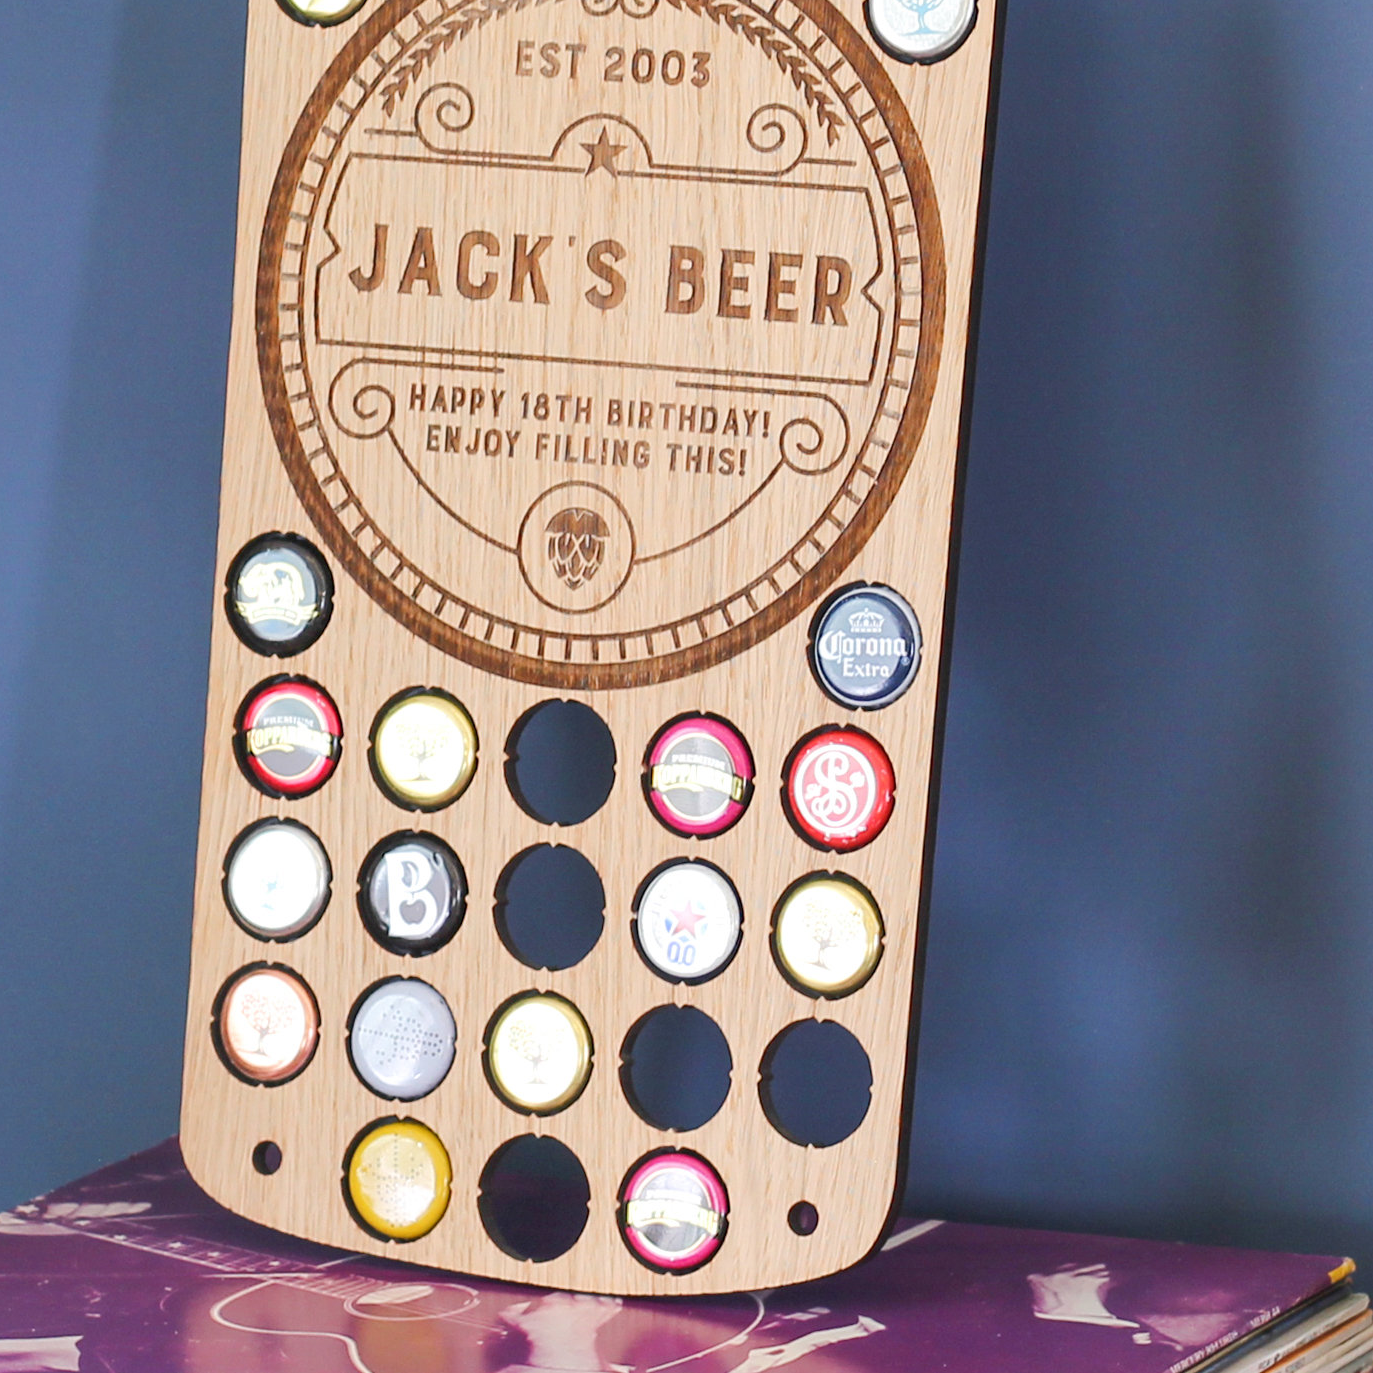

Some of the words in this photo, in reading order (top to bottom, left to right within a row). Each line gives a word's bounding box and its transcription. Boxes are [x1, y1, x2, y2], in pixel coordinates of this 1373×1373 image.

[516, 40, 587, 79] EST
[604, 46, 711, 88] 2003
[348, 223, 627, 310] JACK'S
[664, 245, 853, 326] BEER
[409, 383, 506, 418] HAPPY
[521, 391, 593, 424] 18TH
[608, 398, 771, 438] BIRTHDAY!
[426, 424, 521, 458] ENJOY
[535, 433, 651, 469] FILLING
[666, 442, 748, 476] THIS!
[818, 630, 908, 664] Corona
[842, 657, 890, 677] Extra
